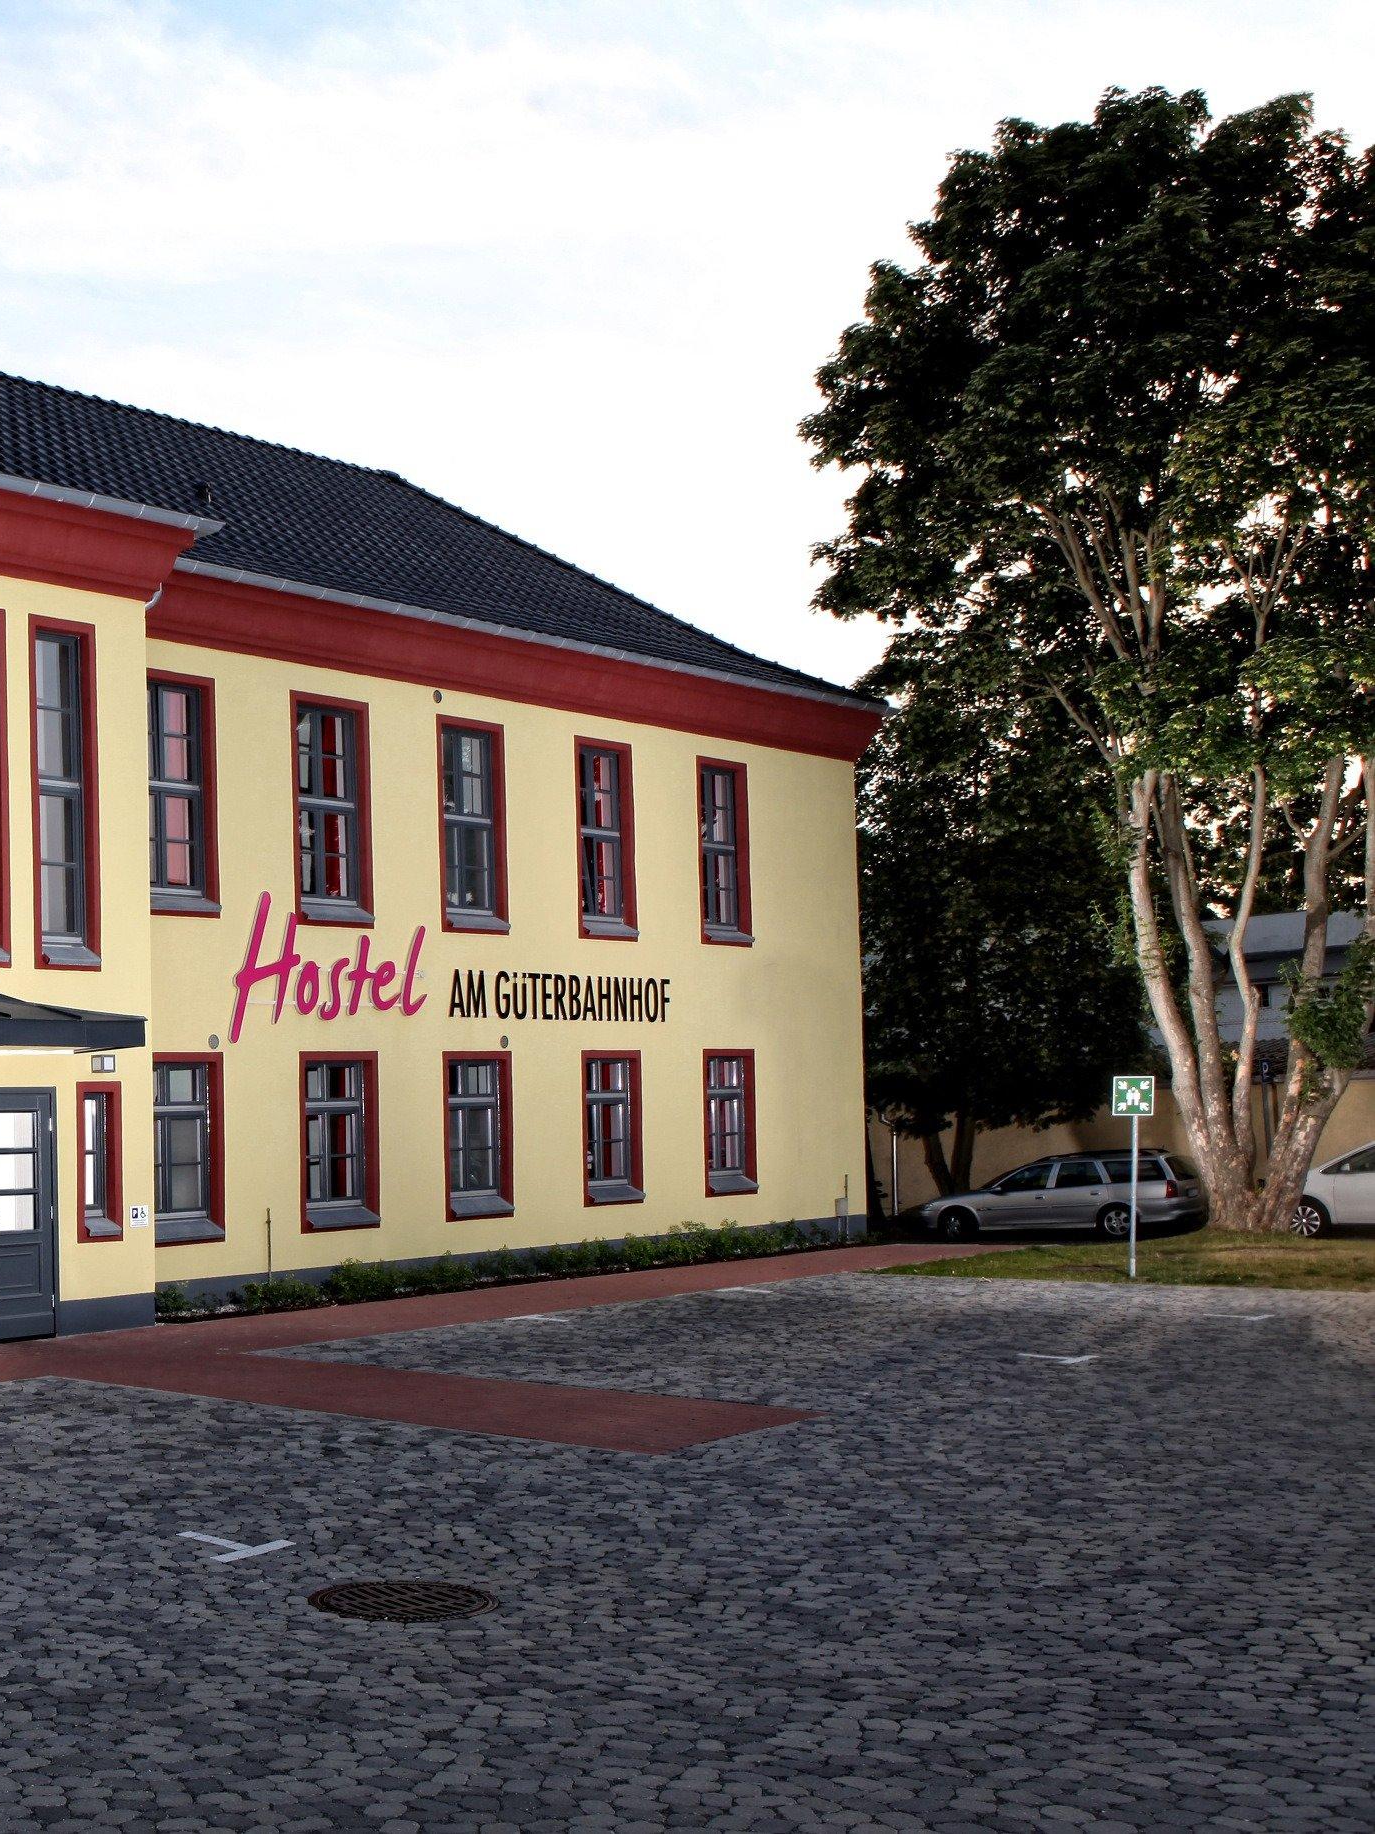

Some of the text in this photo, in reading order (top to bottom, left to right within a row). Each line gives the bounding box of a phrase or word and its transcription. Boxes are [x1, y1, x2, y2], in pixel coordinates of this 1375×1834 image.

[228, 891, 671, 1043] Hostel AM GÜTERBAHNHOF
